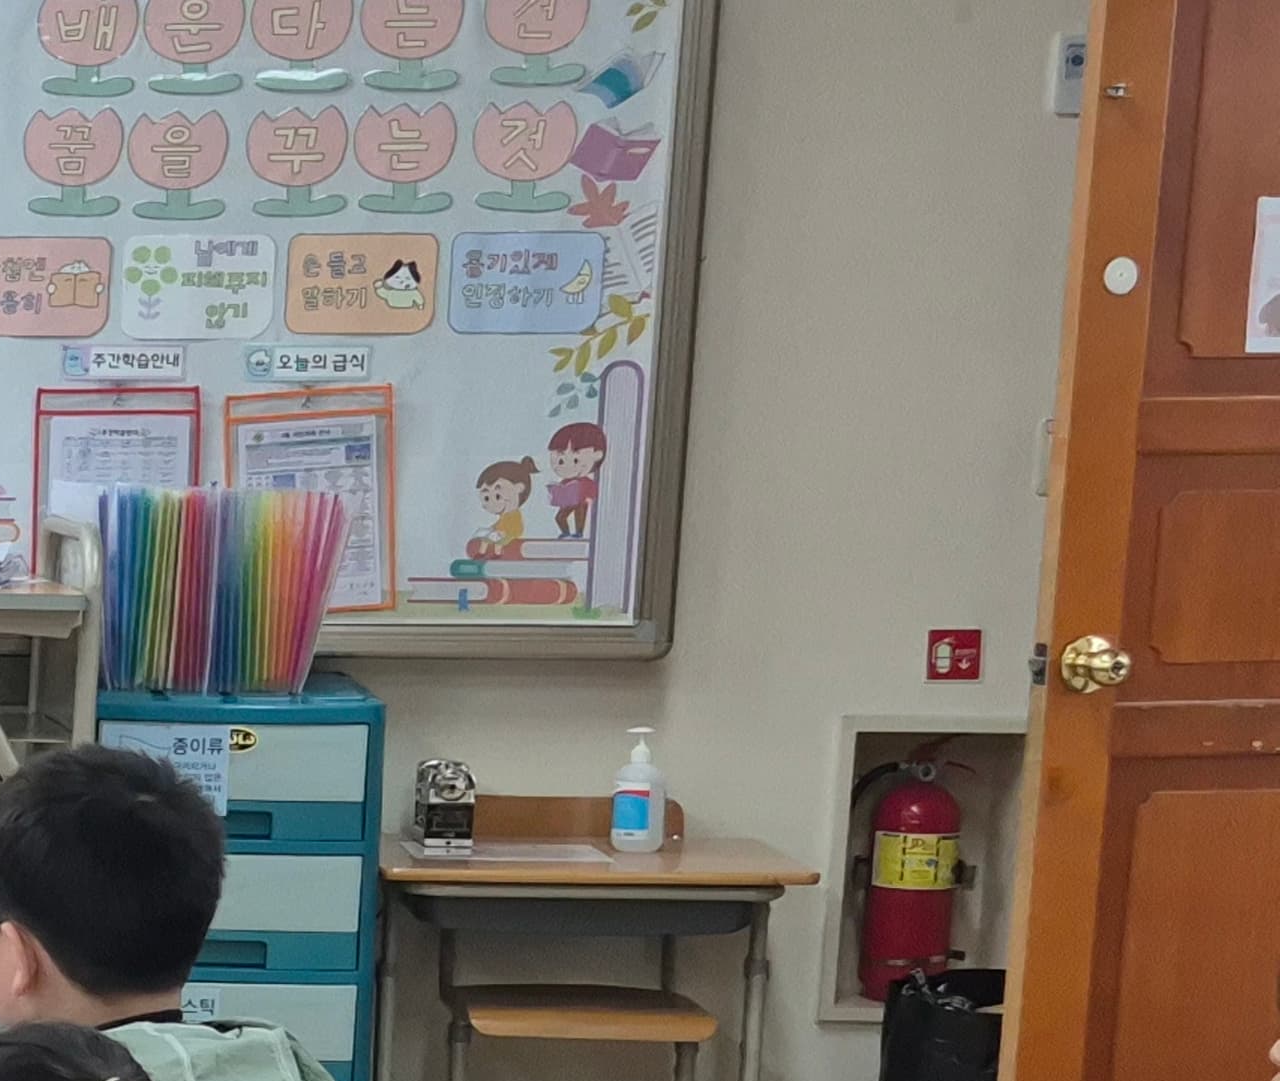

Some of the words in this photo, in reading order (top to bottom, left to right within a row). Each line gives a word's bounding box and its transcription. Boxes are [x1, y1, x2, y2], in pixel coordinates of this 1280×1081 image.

[48, 123, 201, 178] 꿈을
[267, 118, 430, 176] 꾸는
[499, 117, 546, 171] 것
[91, 352, 181, 370] 주간학습안내
[276, 354, 328, 372] 오늘의
[332, 353, 367, 372] 급식
[172, 737, 224, 756] 종이류
